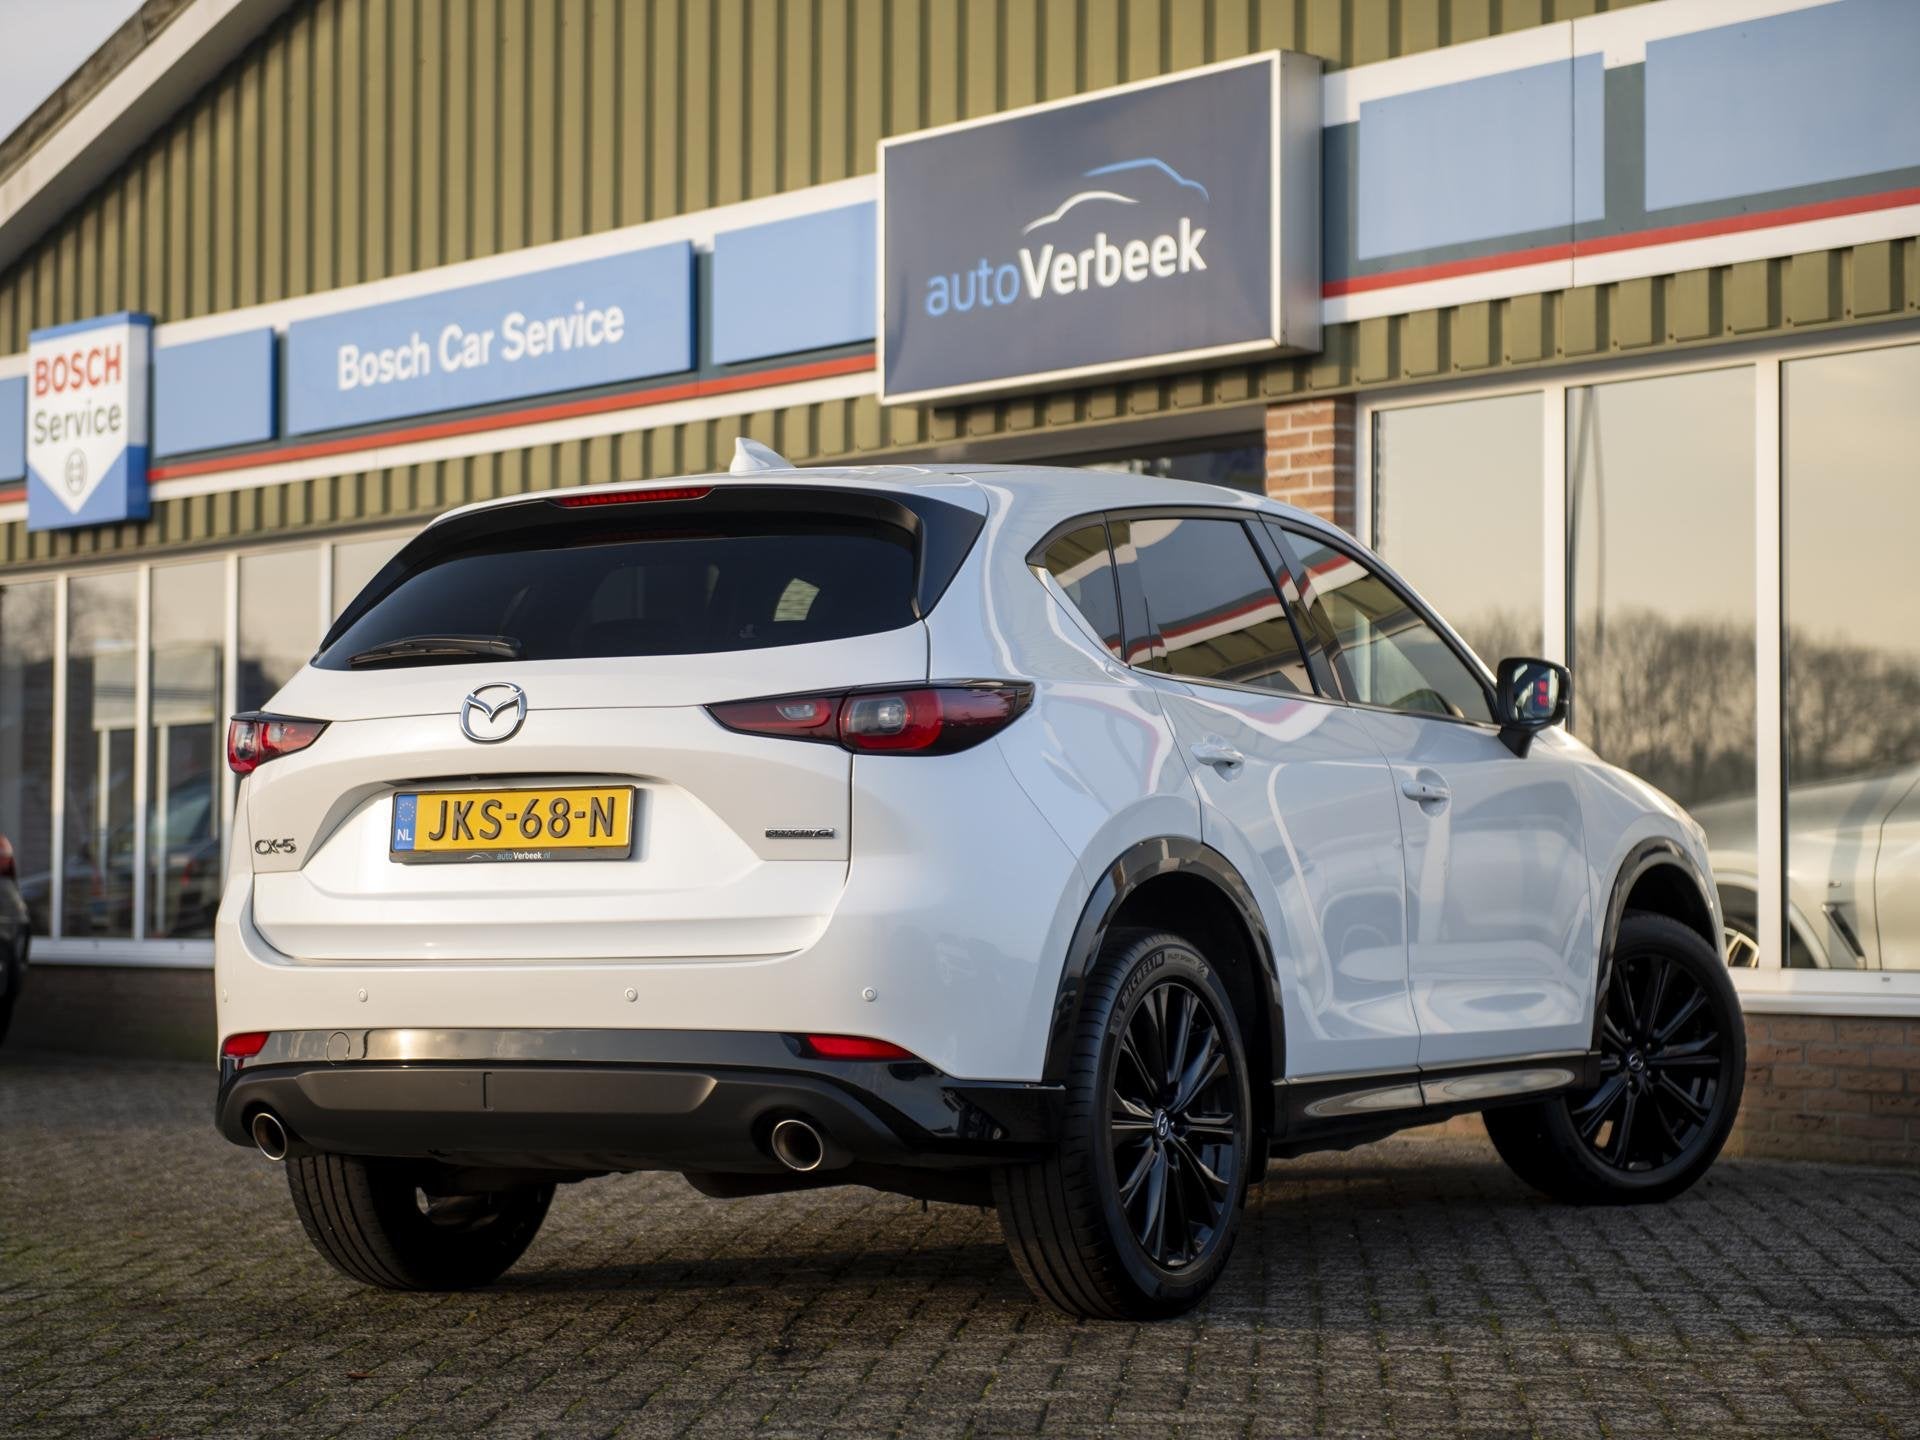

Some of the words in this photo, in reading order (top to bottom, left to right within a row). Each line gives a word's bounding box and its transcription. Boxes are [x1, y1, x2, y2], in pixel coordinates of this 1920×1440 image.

[926, 216, 1208, 318] autoVerbeek
[338, 332, 430, 391] Bosch
[438, 323, 494, 372] Car
[501, 300, 625, 362] Service
[35, 344, 121, 397] BOSCH
[34, 400, 122, 445] Service
[397, 829, 412, 842] NL
[428, 796, 615, 842] JKS-68-N
[254, 837, 297, 855] CX-5
[1120, 952, 1164, 1009] MICHELIN
